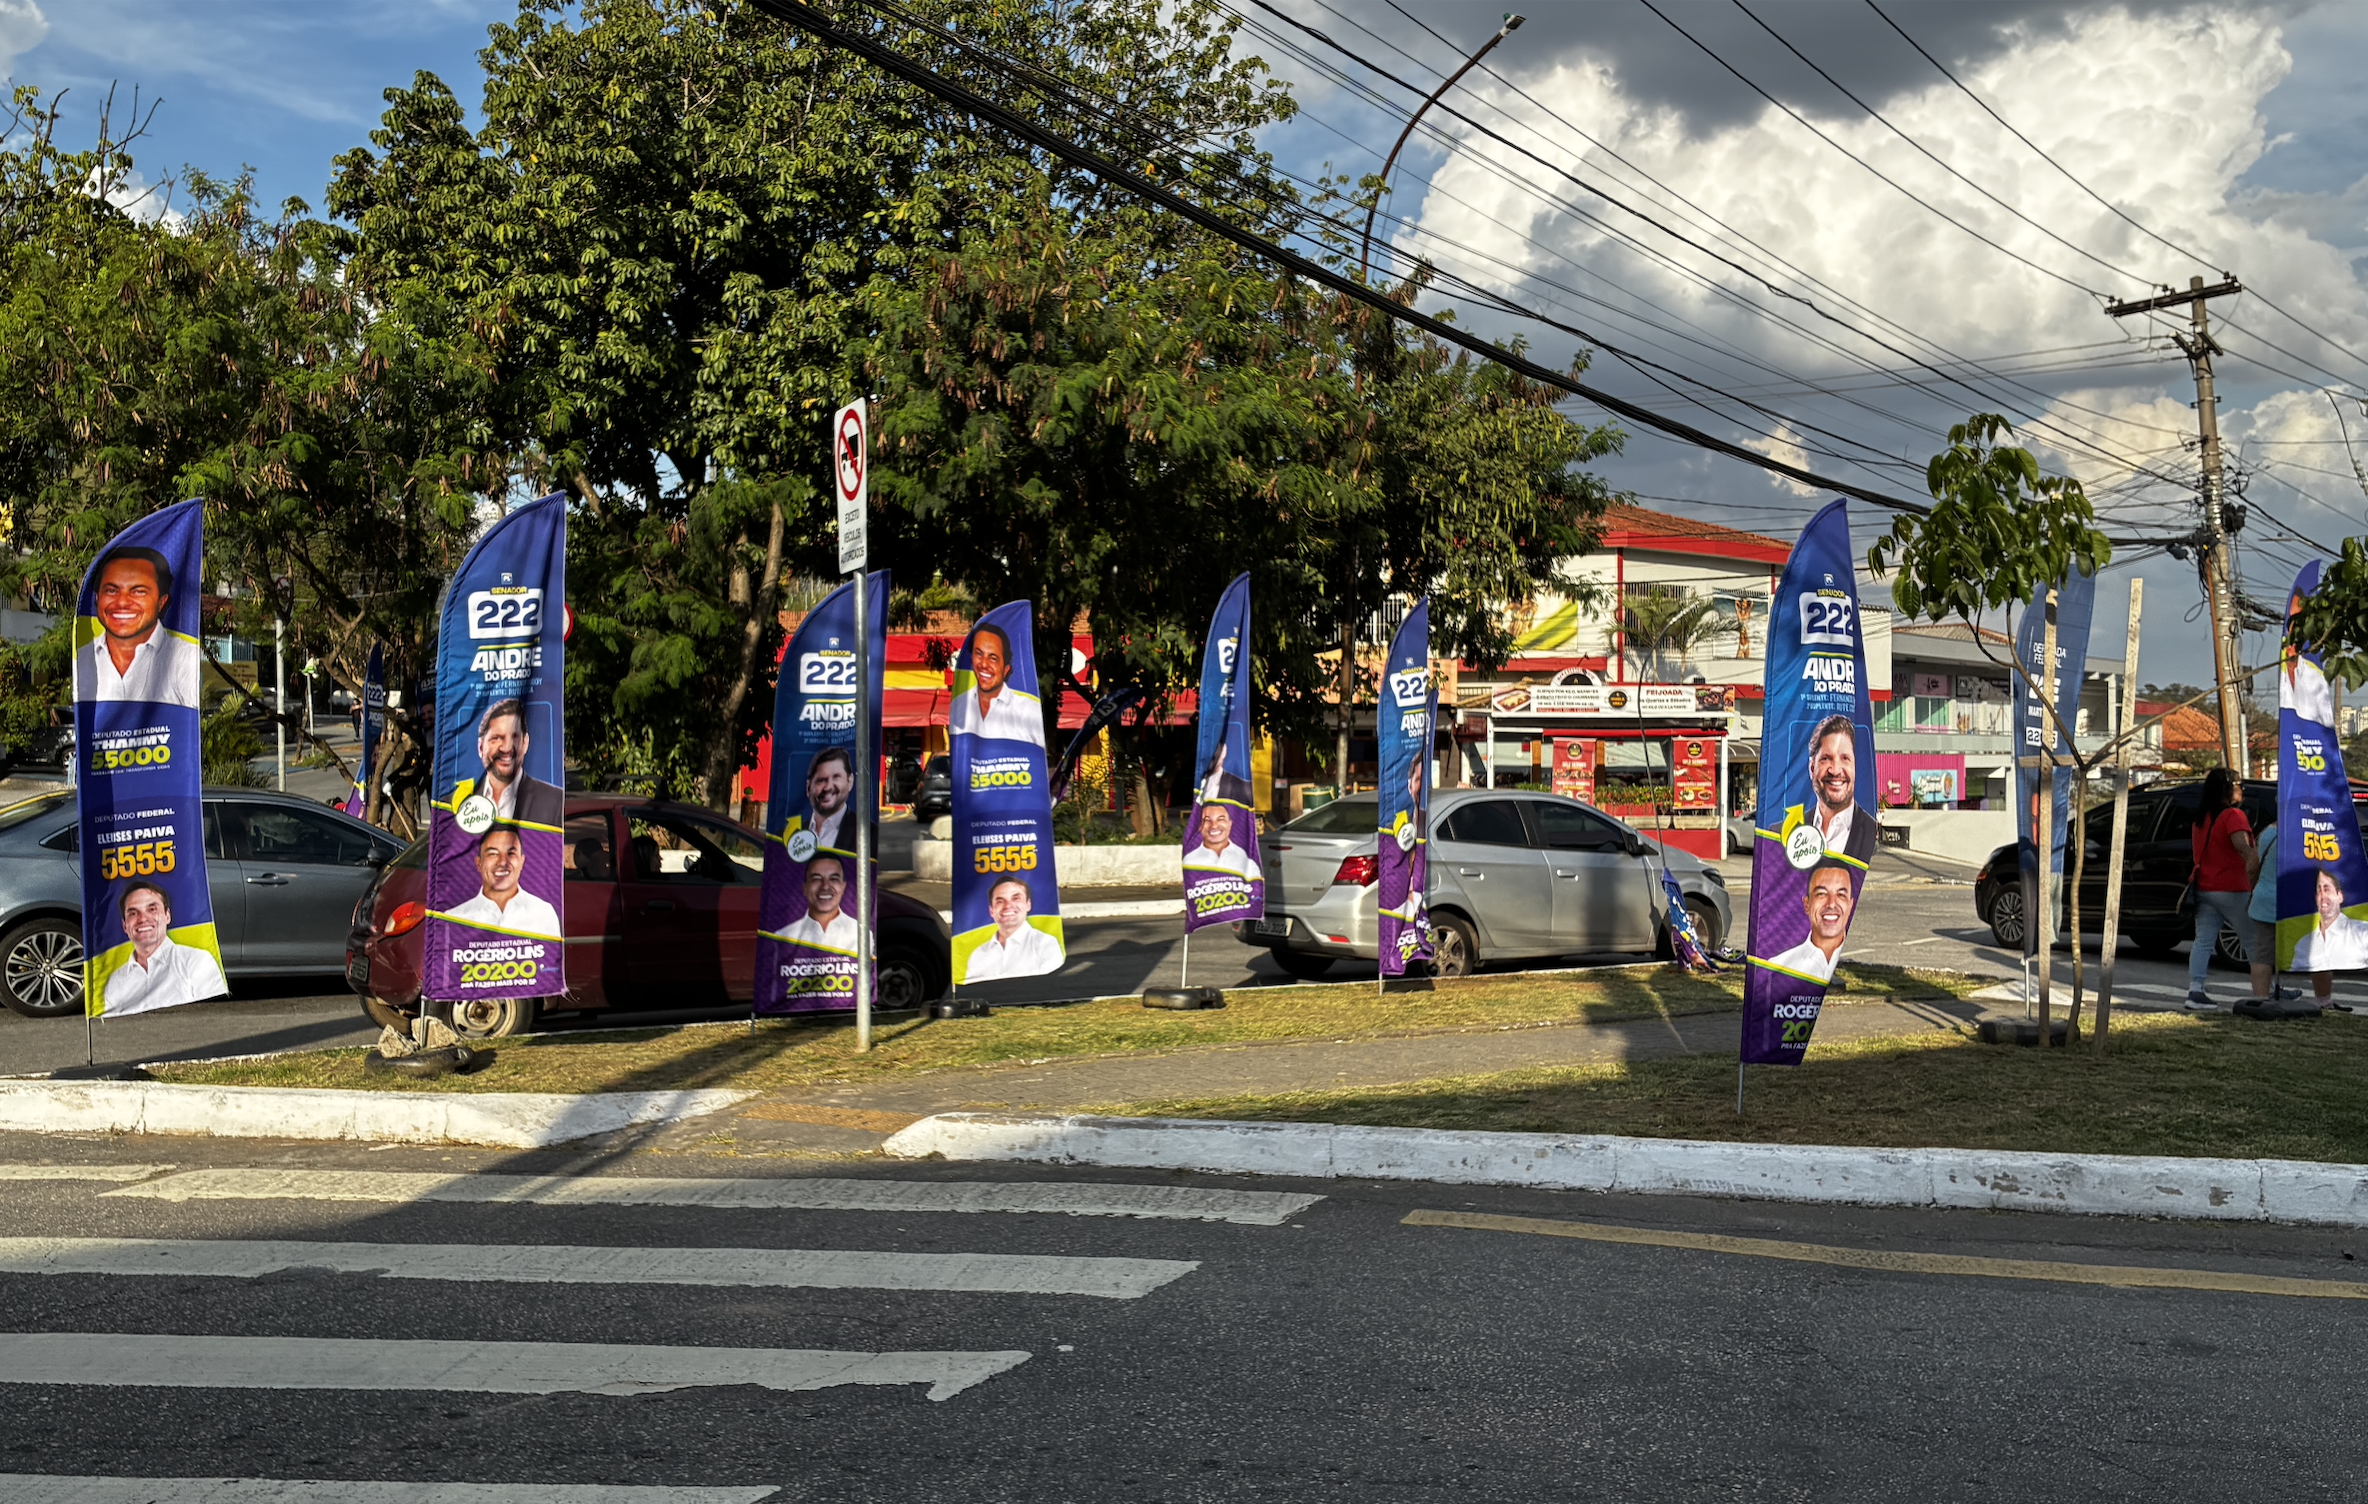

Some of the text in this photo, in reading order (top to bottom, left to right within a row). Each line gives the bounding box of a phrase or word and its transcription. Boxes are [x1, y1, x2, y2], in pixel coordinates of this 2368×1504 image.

[491, 586, 527, 595] SENADOR
[1817, 589, 1845, 598] SENADOR
[477, 598, 540, 629] 222
[485, 668, 531, 681] DO PRADO
[1802, 658, 1854, 683] ANDR
[799, 703, 856, 721] ANDR
[92, 725, 171, 739] DEPUTADO ESTADUAL
[811, 719, 856, 730] DO PRADO
[92, 733, 171, 750] THAMMY
[91, 745, 171, 770] 55000
[971, 763, 1030, 774] THAMMY
[970, 771, 1032, 788] 55000
[95, 808, 175, 823] DEPUTADO FEDERAL
[463, 801, 479, 816] Eu
[134, 825, 175, 839] PAIVA
[972, 833, 1037, 844] ELEUSES PAIVA
[1794, 832, 1809, 849] Eu
[101, 839, 176, 880] 5555
[974, 844, 1037, 874] 5555
[1187, 881, 1232, 899] ROGÉRIO
[1194, 892, 1248, 913] 20200
[452, 944, 545, 962] ROGÉRIO LINS
[460, 960, 537, 982] 20200
[780, 963, 835, 976] ROGÉRIO
[786, 975, 854, 994] 20200
[1773, 1003, 1820, 1019] ROGÉR
